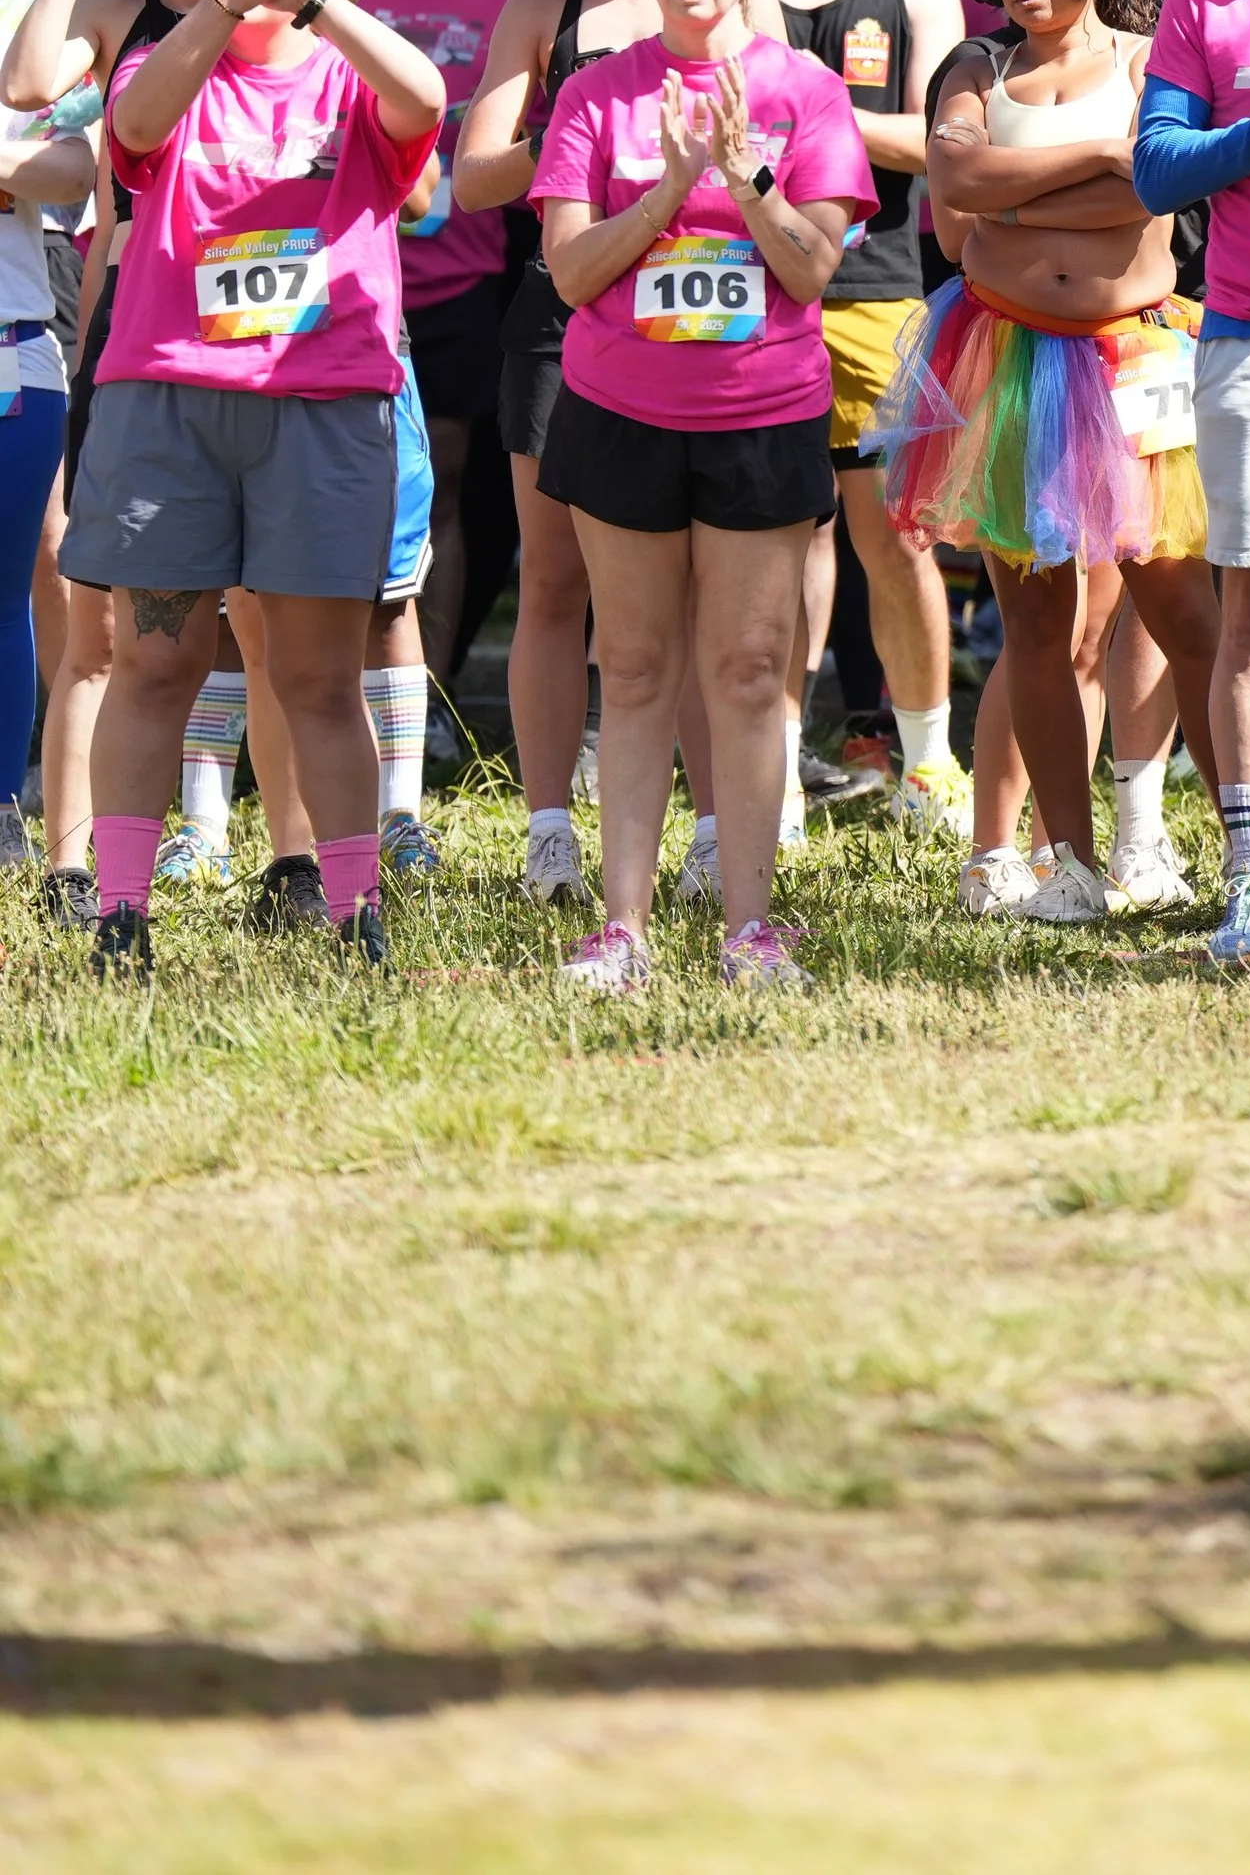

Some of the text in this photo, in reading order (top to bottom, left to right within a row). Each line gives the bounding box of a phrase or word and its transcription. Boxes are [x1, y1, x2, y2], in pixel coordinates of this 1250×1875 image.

[847, 35, 888, 48] EMU
[204, 238, 318, 260] Silicon Valley PRIDE
[646, 247, 754, 264] Silicon Valley PRIDE
[216, 263, 308, 306] 107
[654, 270, 749, 309] 106
[700, 319, 725, 331] 2025
